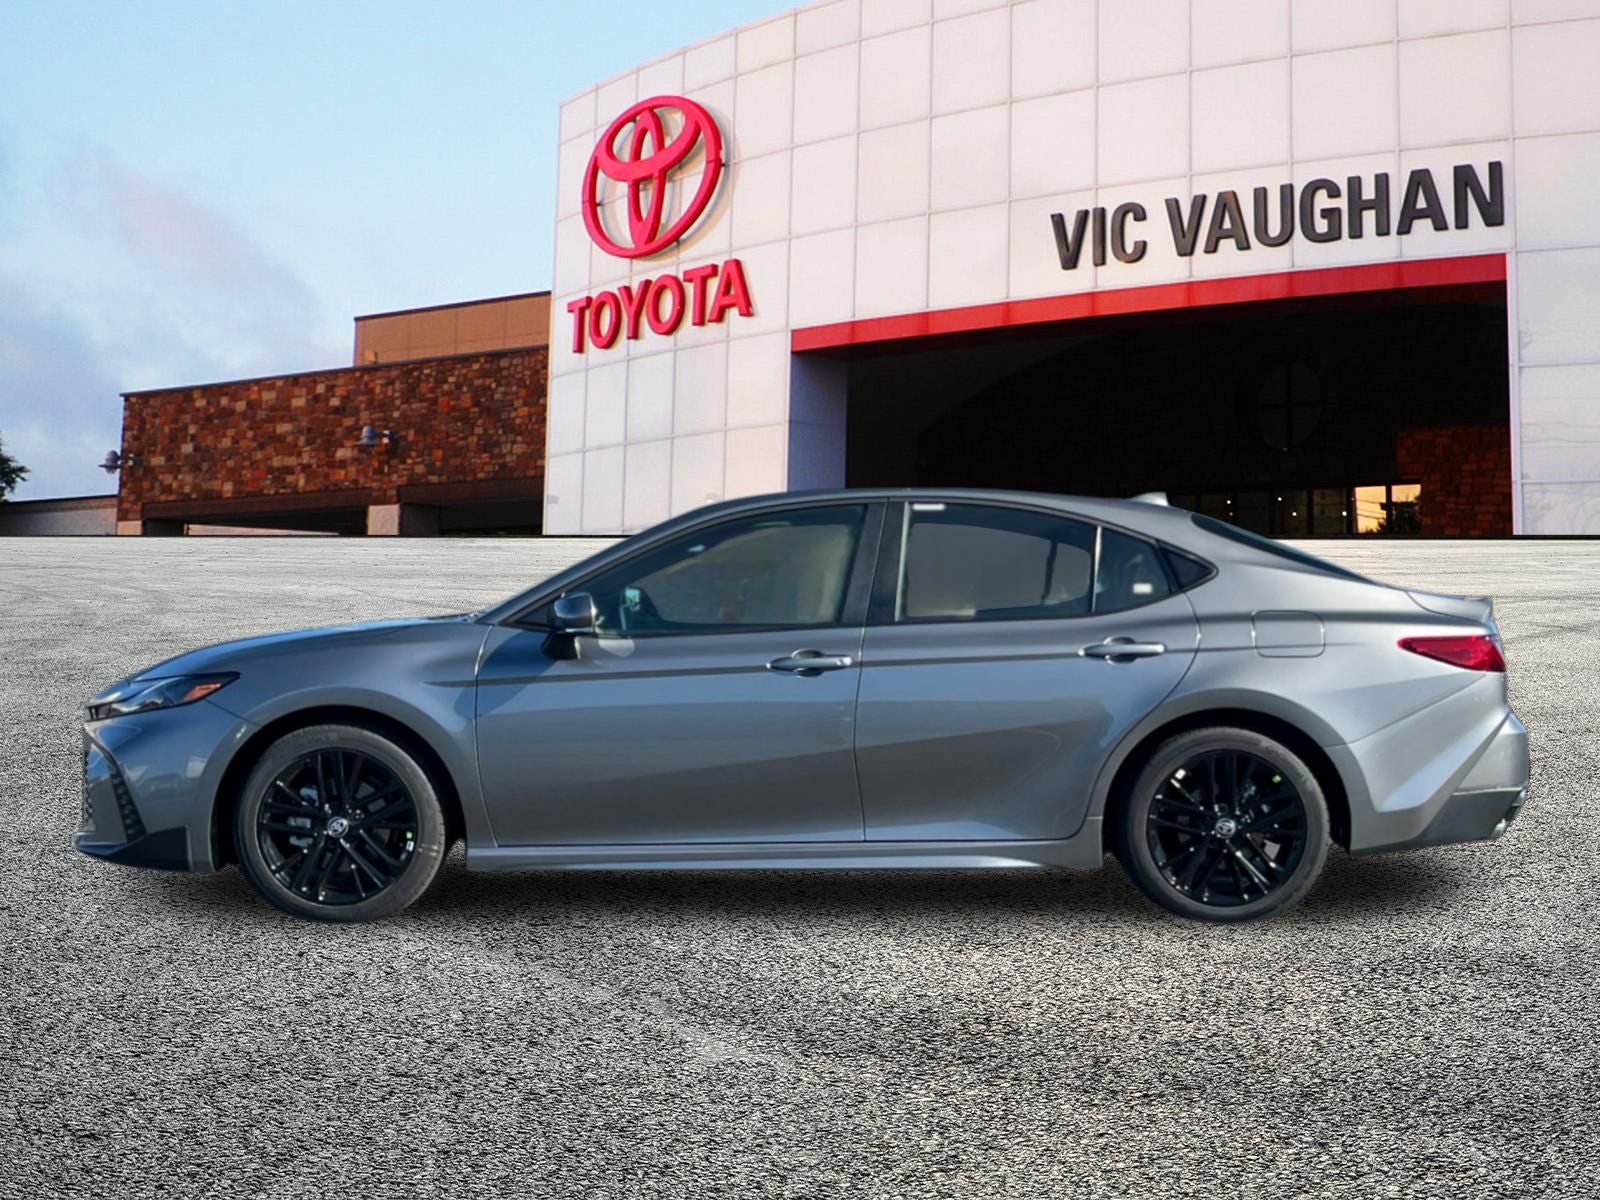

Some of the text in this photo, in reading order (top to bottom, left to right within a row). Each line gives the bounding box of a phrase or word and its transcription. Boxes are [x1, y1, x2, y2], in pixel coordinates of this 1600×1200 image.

[1051, 161, 1504, 270] VIC VAUGHAN
[568, 259, 754, 353] TOYOTA
